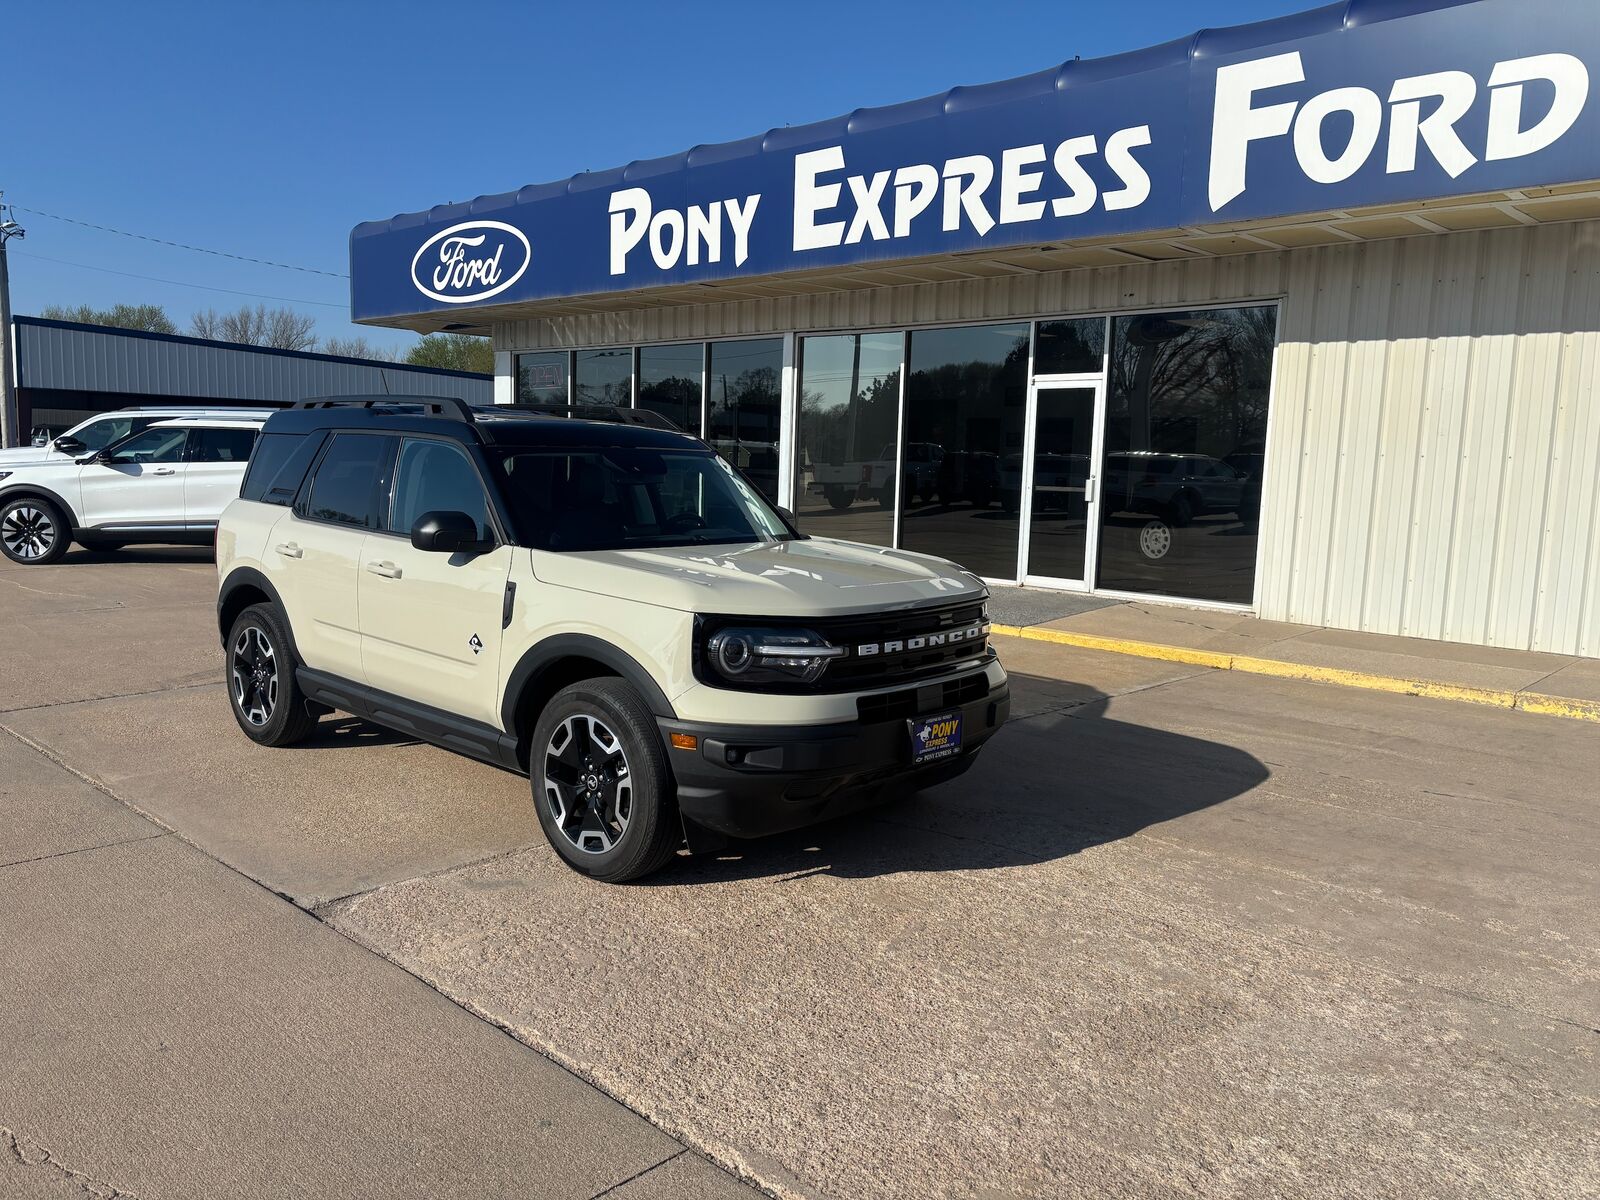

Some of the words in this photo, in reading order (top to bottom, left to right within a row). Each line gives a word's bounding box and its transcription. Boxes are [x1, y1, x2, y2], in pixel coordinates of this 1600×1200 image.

[433, 234, 504, 291] Ford
[531, 367, 563, 387] OPEN
[858, 627, 979, 656] BRONCO
[931, 719, 959, 739] PONY
[925, 737, 948, 748] EXPRESS
